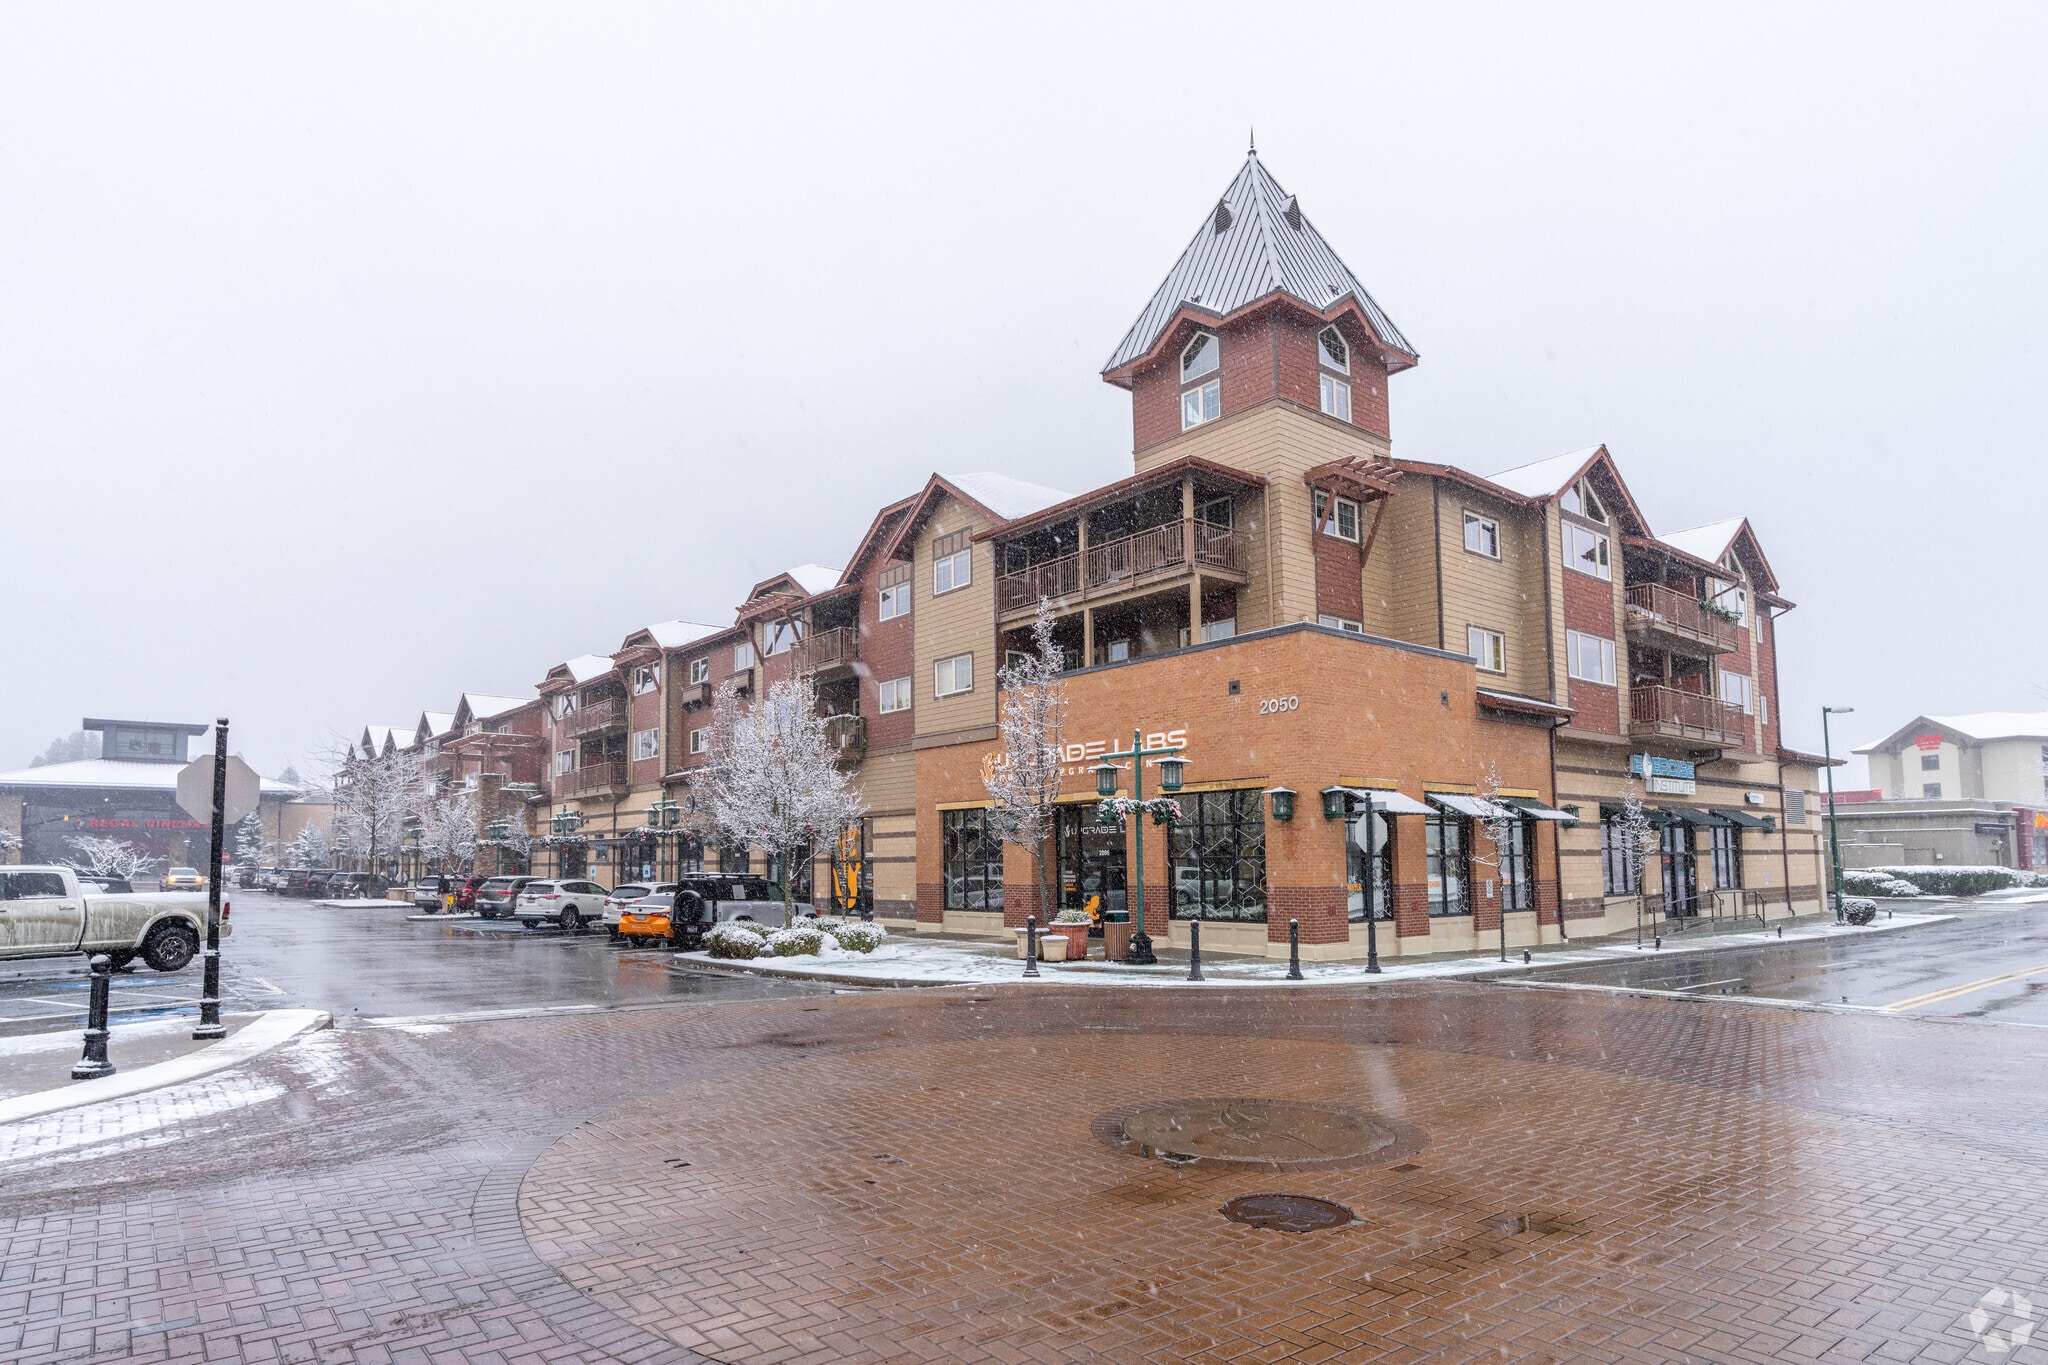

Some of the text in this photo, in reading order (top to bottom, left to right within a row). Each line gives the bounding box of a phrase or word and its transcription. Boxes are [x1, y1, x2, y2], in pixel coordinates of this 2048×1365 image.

[1259, 695, 1299, 715] 2050
[1634, 754, 1695, 779] EERCISE
[89, 818, 138, 829] REGAL
[1071, 825, 1117, 835] UGRADE
